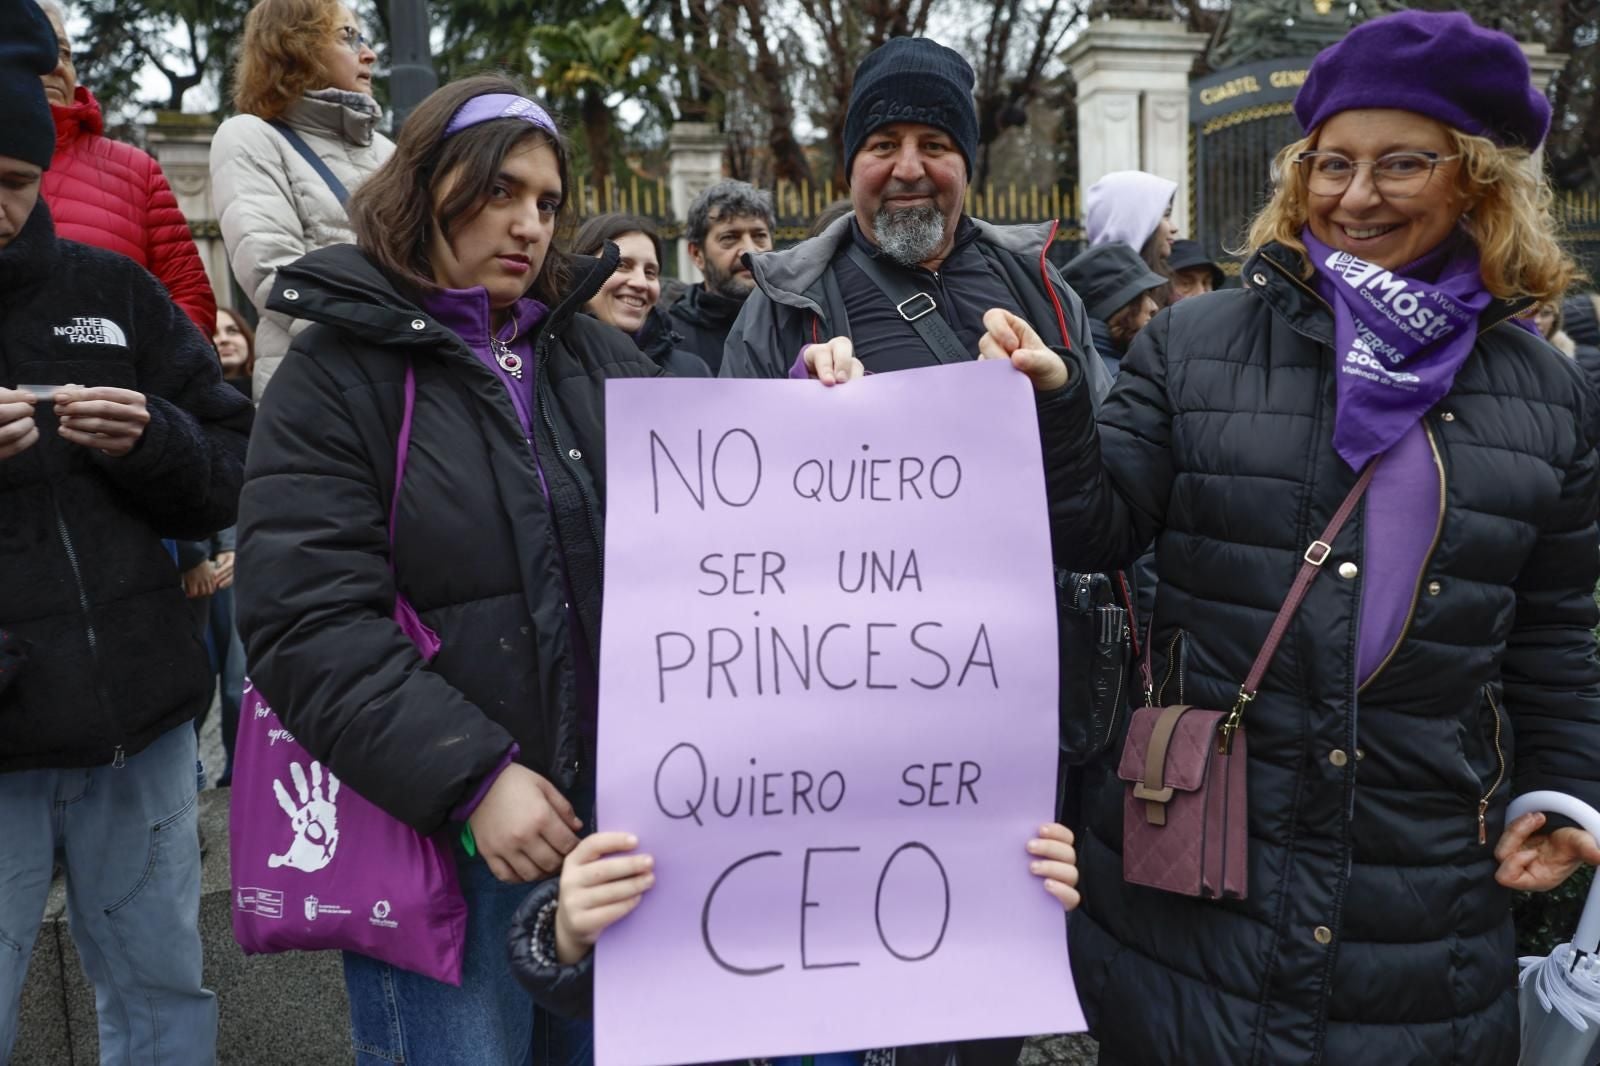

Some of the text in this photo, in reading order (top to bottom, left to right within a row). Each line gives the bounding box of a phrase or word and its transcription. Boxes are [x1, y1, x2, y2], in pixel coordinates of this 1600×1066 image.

[1200, 75, 1261, 105] CUARTEL
[53, 325, 104, 336] NORTH
[69, 334, 105, 344] FACE
[72, 317, 102, 326] THE
[650, 427, 762, 515] NO
[698, 548, 923, 597] SER UNA
[897, 760, 982, 808] SER
[700, 840, 951, 977] CEO
